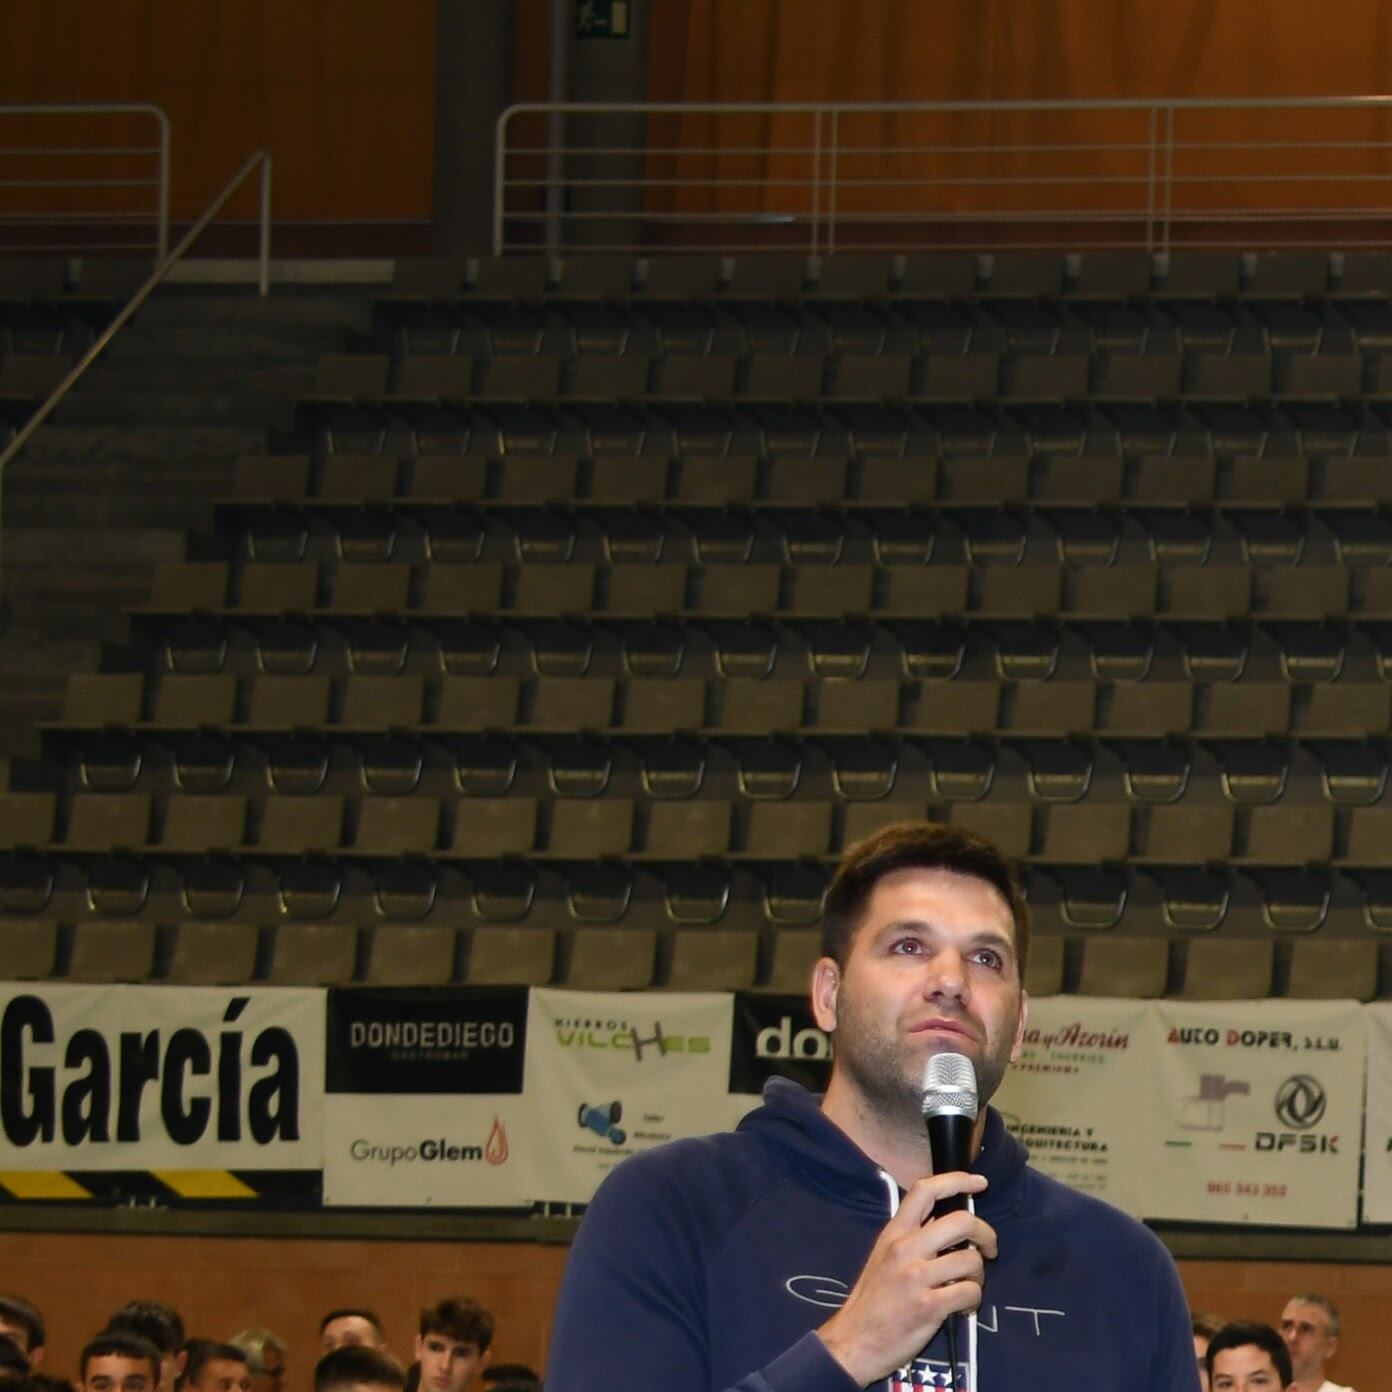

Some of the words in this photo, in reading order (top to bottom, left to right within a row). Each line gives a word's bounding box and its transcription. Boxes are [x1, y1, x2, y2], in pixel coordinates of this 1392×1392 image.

[350, 1022, 514, 1049] DONDEDIEGO
[756, 1016, 833, 1060] do
[1167, 1026, 1219, 1047] AUTO
[0, 995, 300, 1146] García
[350, 1138, 483, 1169] GrupoGlem
[1254, 1132, 1340, 1155] DFSK
